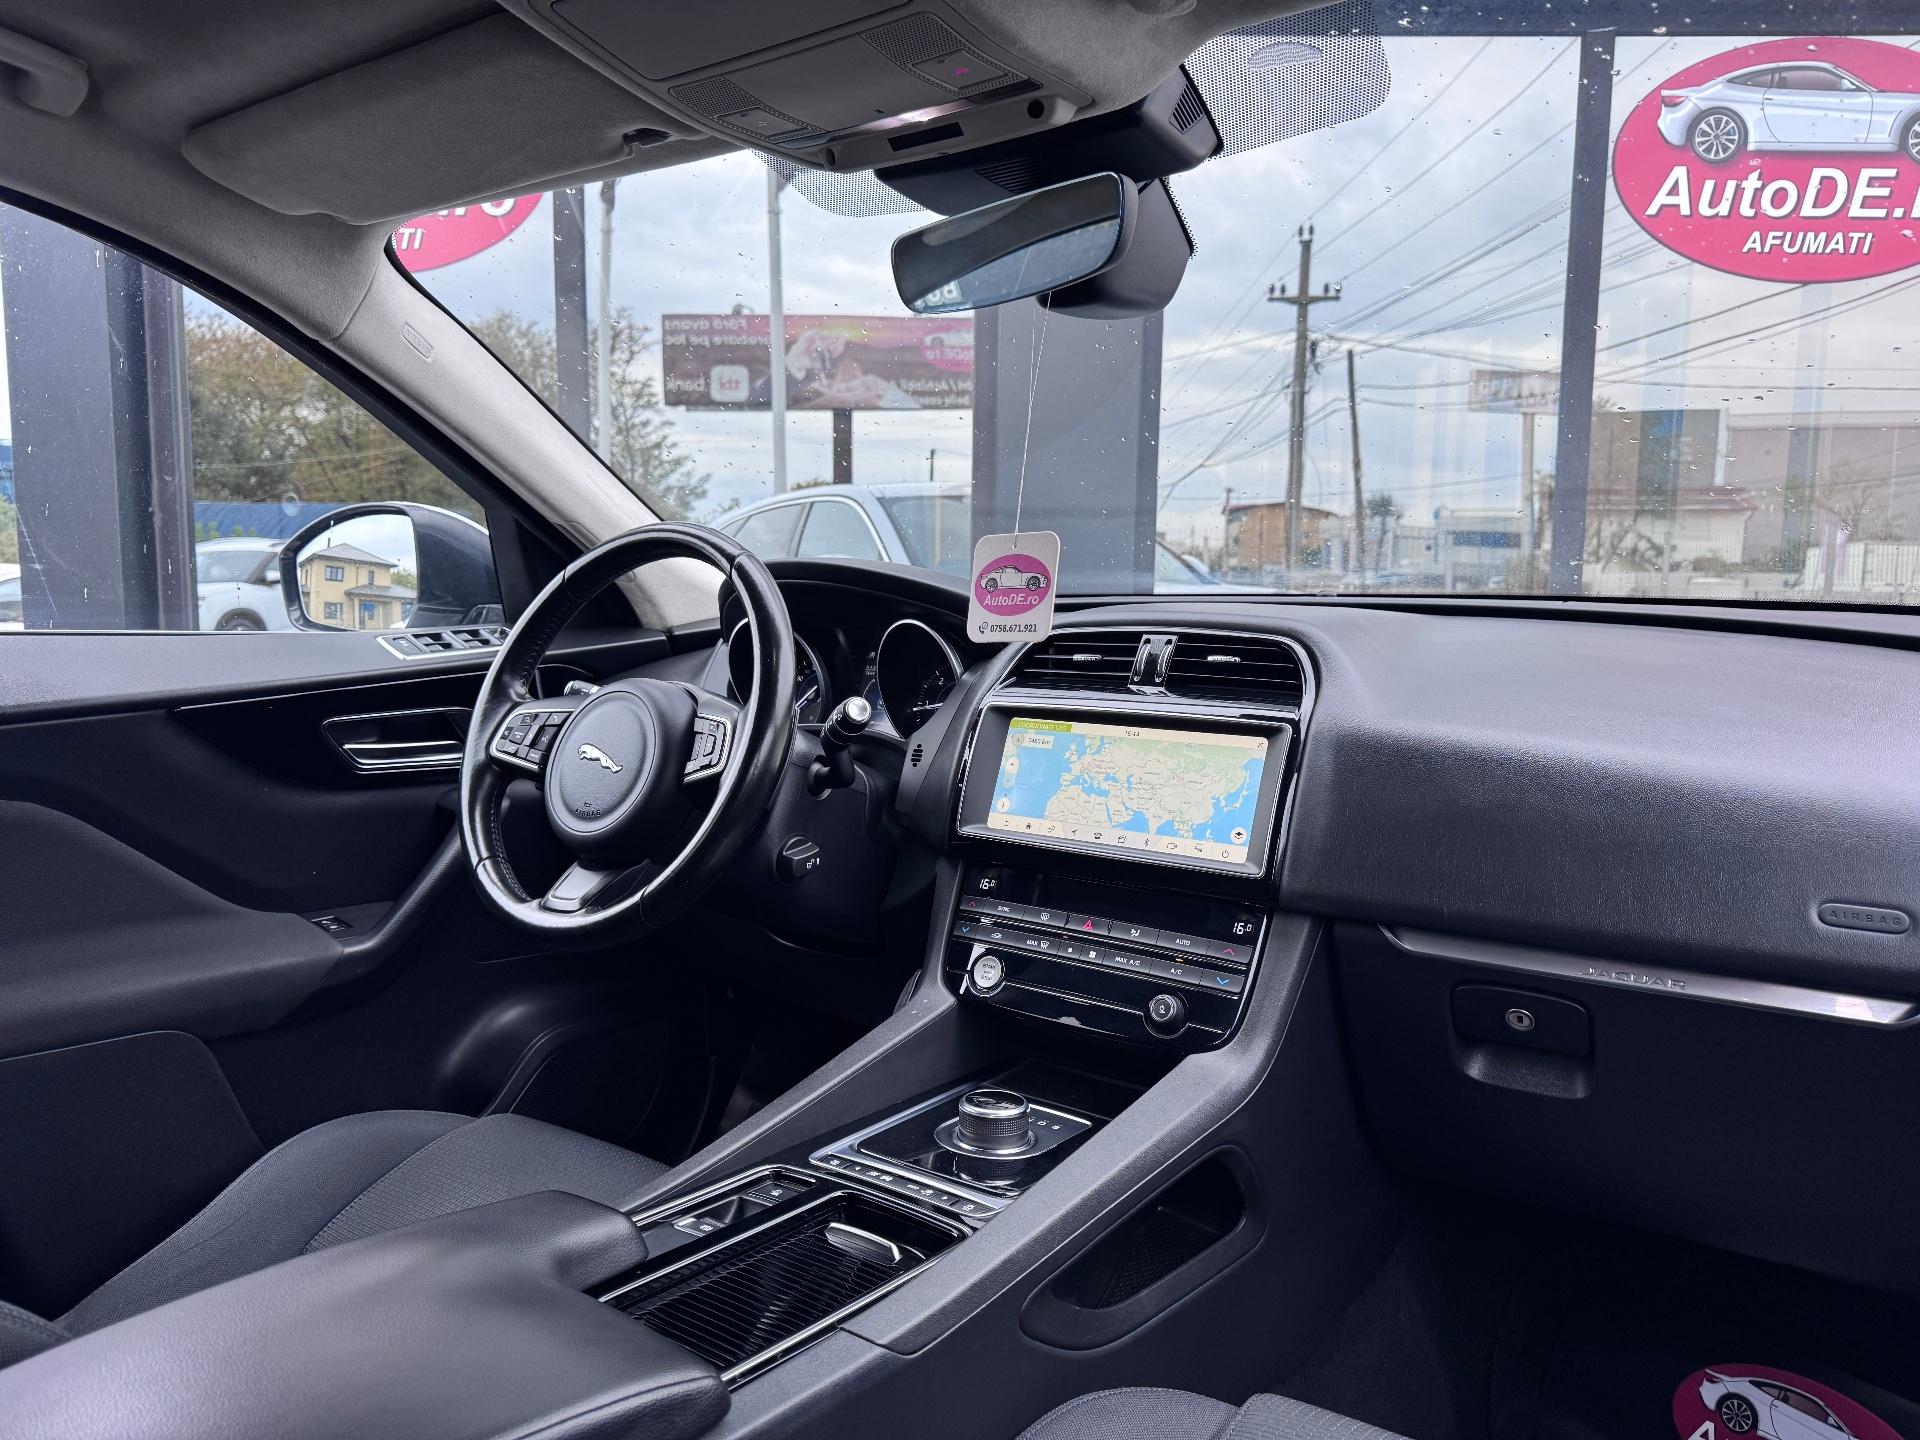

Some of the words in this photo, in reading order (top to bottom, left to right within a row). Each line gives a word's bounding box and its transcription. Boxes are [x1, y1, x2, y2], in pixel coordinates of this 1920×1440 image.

[1741, 231, 1873, 254] AFUMATI
[983, 593, 1040, 606] AutoDE.ro
[990, 623, 1037, 633] 0758.671.921
[1830, 909, 1901, 926] AIRBAG
[1233, 922, 1252, 935] 16.0
[1176, 938, 1191, 946] AUTO
[1115, 956, 1127, 964] MAX
[1578, 967, 1687, 990] JAGUAR
